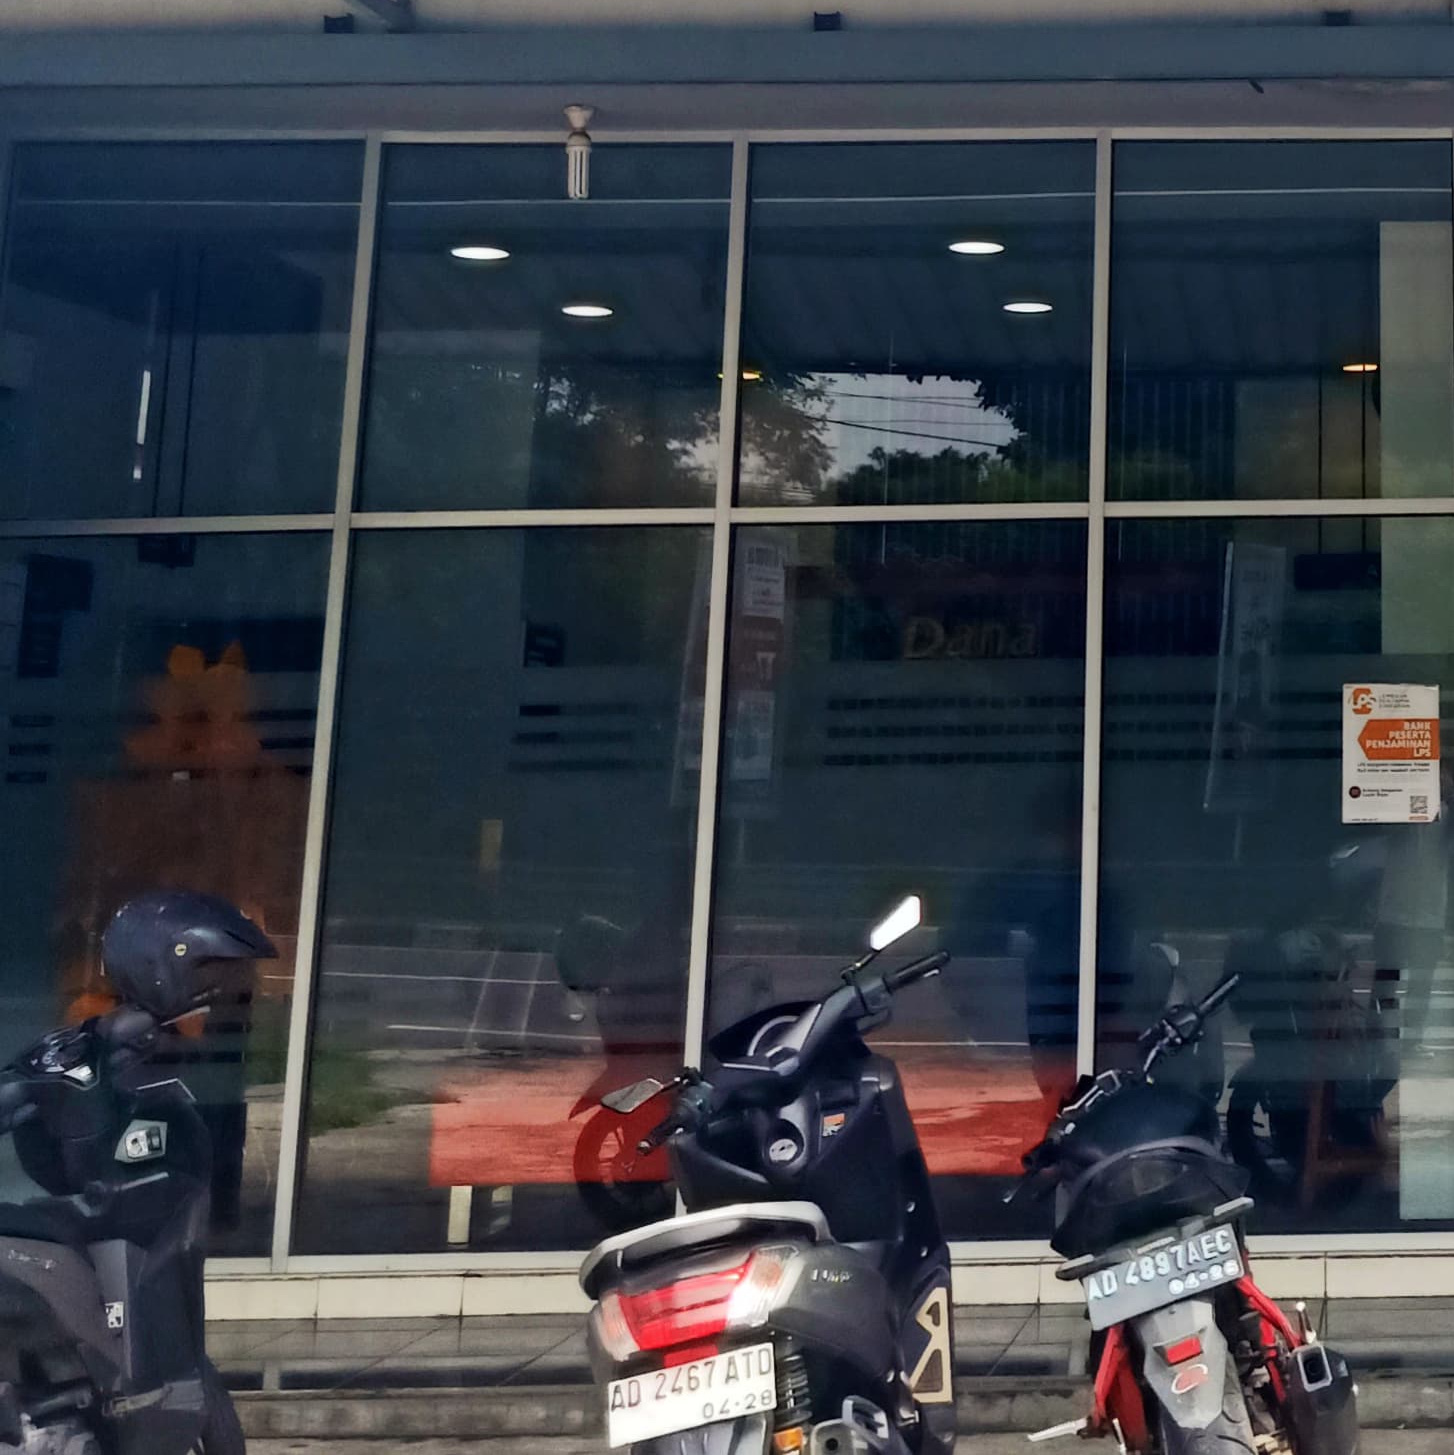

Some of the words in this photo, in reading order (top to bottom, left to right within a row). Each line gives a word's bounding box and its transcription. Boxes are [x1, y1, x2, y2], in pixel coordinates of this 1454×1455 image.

[1404, 722, 1431, 730] BANK
[1389, 731, 1431, 739] PESERTA
[1366, 740, 1431, 748] PENJAMINAN
[1414, 748, 1431, 757] LPS
[1089, 1269, 1118, 1301] AD
[611, 1379, 641, 1413] AD
[655, 1360, 716, 1401] 2467
[724, 1348, 772, 1385] ATD
